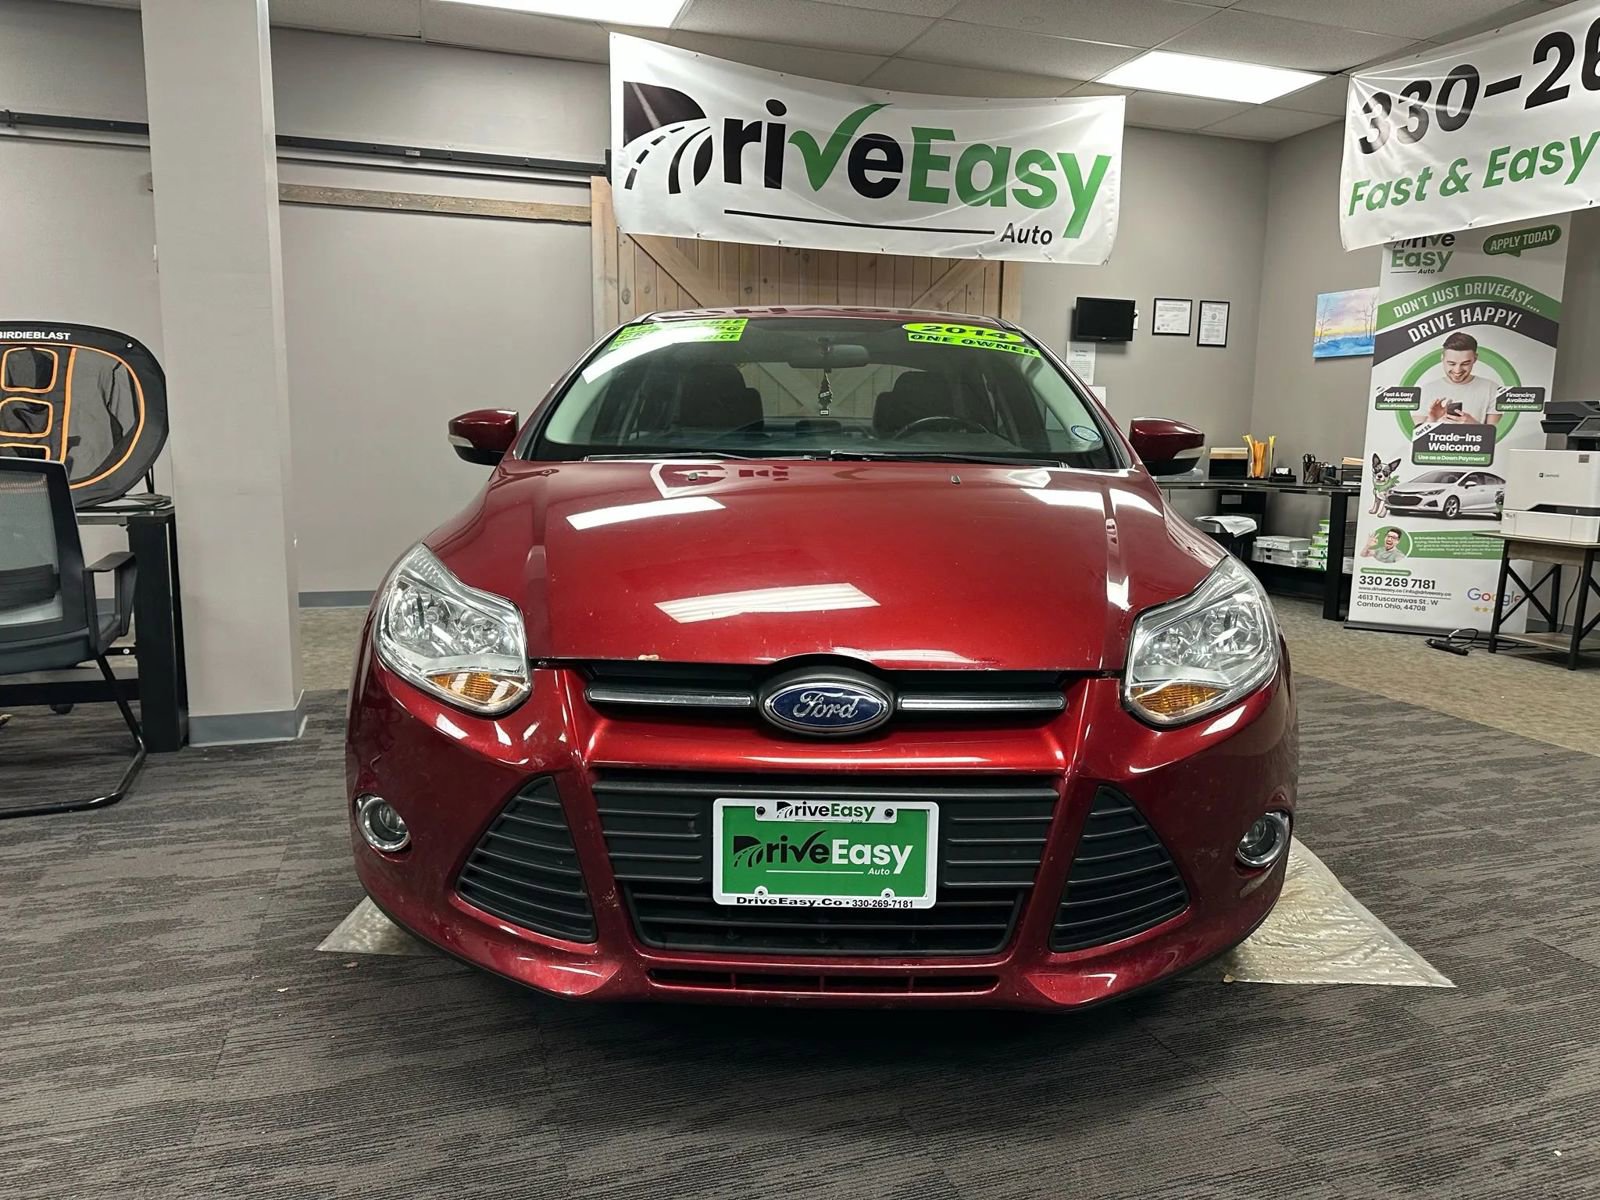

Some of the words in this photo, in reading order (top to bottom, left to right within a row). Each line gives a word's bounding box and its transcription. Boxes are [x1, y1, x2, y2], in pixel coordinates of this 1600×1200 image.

[623, 81, 1112, 239] DriveEasy
[1348, 166, 1434, 217] Fast
[1439, 157, 1472, 197] &
[1482, 131, 1600, 189] Easy
[1000, 222, 1053, 246] Auto
[1490, 235, 1521, 251] APPLY
[1523, 228, 1556, 246] TODAY
[1391, 250, 1454, 273] Easy
[1393, 295, 1429, 318] DON'T
[1432, 285, 1461, 305] JUST
[921, 325, 1011, 340] 2014
[1407, 313, 1455, 344] DRIVE
[1460, 306, 1523, 329] HAPPY!
[0, 331, 72, 341] BIRDIEBLAST
[910, 334, 955, 342] ONE
[961, 339, 1036, 355] OWNER
[1428, 433, 1483, 442] Trade-Ins
[1428, 442, 1481, 452] Welcome
[1359, 575, 1383, 586] 330
[1385, 577, 1408, 588] 269
[1411, 579, 1436, 589] 7181
[1356, 601, 1383, 609] Canton
[1384, 602, 1403, 611] Ohio,
[1404, 604, 1426, 612] 44708
[1375, 595, 1418, 604] Tuscarawas
[792, 690, 861, 719] Ford
[776, 801, 876, 822] DriveEasy
[733, 830, 914, 875] DriveEasy
[868, 867, 891, 876] Auto
[736, 896, 843, 908] DriveEasy.Co
[852, 899, 914, 908] 330-269-7181
